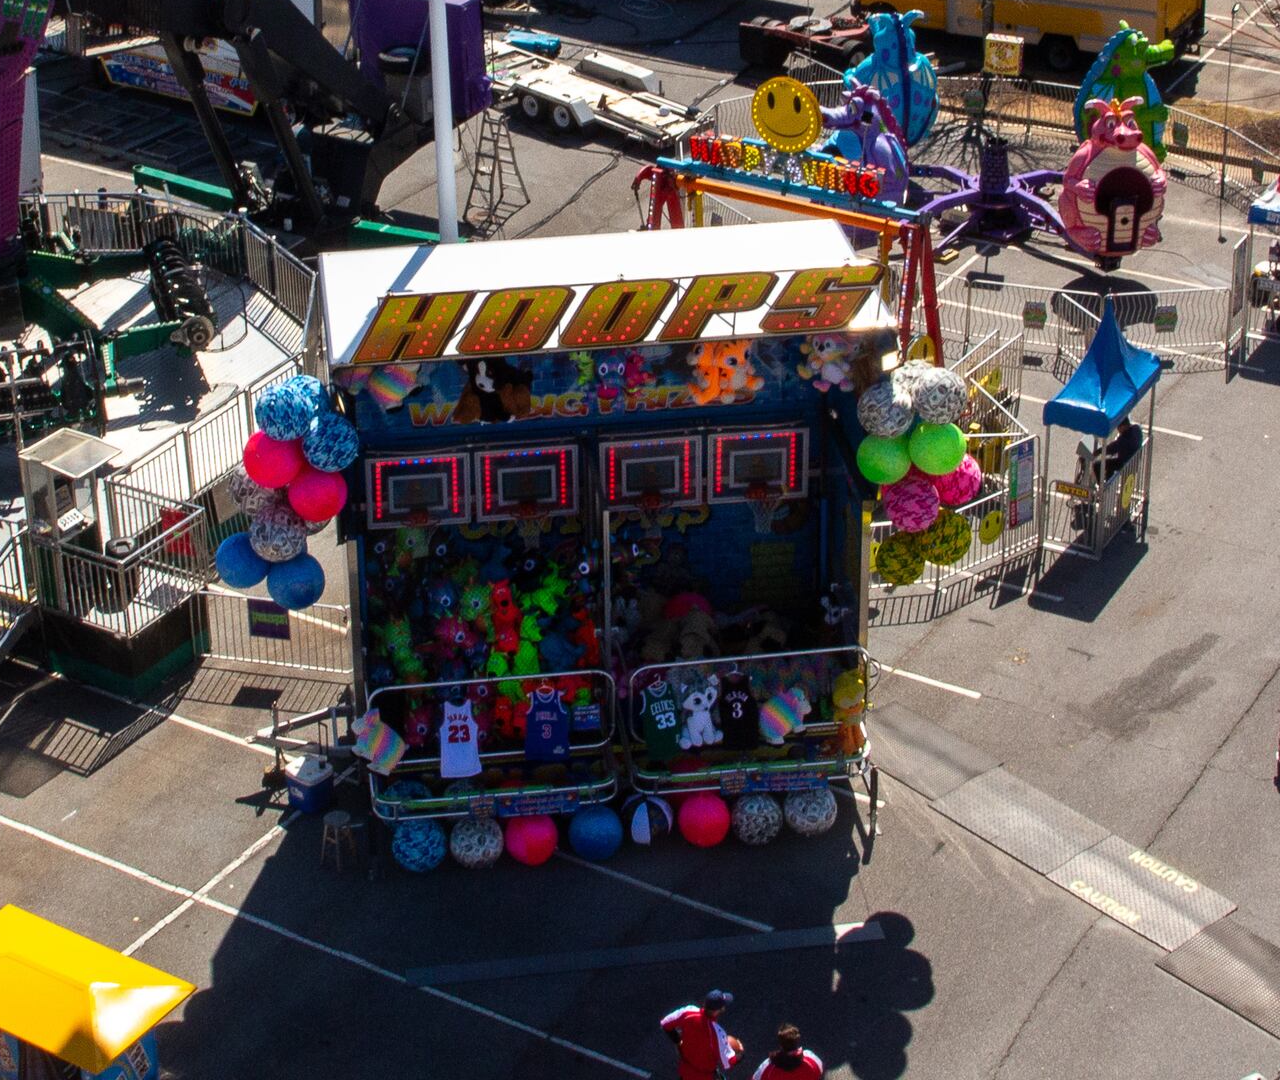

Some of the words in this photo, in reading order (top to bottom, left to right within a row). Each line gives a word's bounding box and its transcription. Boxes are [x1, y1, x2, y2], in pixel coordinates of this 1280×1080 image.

[354, 264, 886, 363] HOOPS
[649, 699, 676, 716] CELTICS
[732, 701, 744, 719] 3
[655, 711, 677, 730] 33
[447, 723, 471, 744] 23
[541, 723, 552, 739] 3
